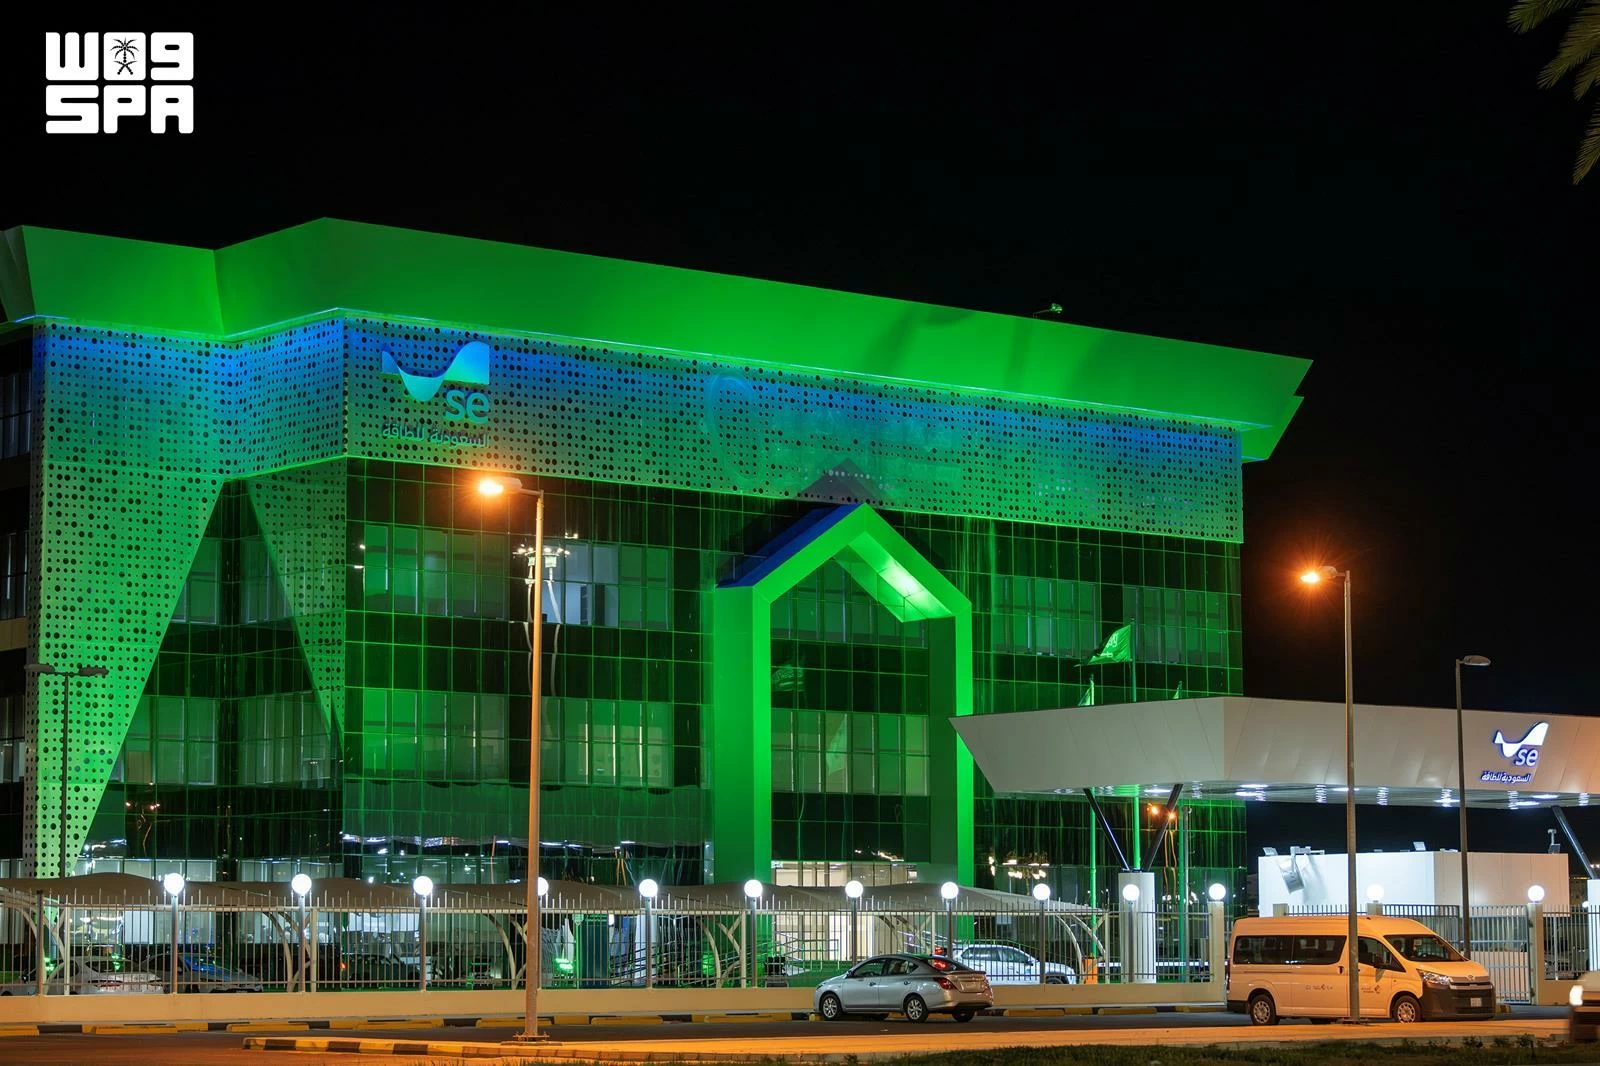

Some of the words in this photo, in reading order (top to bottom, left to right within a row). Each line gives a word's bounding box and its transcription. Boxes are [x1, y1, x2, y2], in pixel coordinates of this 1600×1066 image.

[445, 389, 490, 424] se
[382, 422, 425, 442] للطاقة
[429, 428, 490, 449] السعودية
[1515, 748, 1539, 767] se
[1481, 771, 1502, 782] للطاقة
[1501, 772, 1532, 784] السعودية
